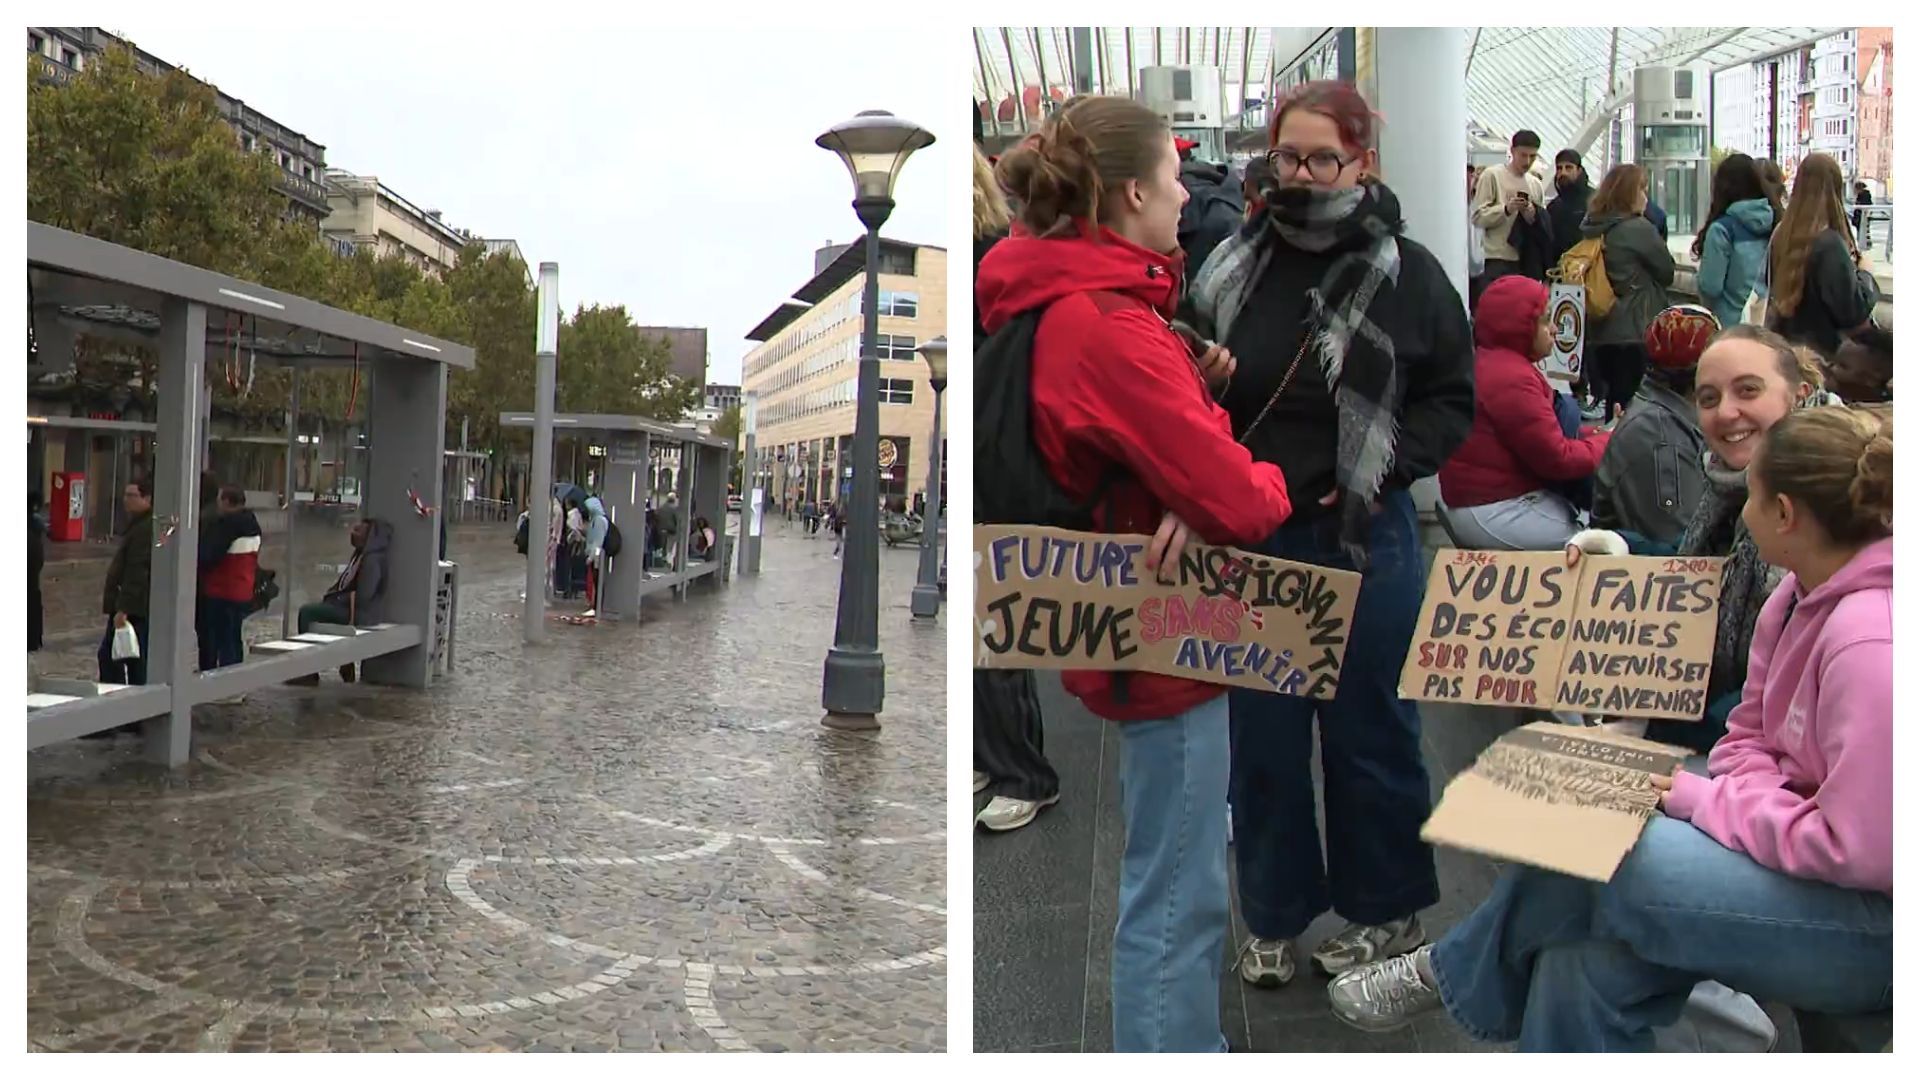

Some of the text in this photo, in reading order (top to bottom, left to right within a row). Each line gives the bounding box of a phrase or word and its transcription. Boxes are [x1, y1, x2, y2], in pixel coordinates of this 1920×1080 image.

[990, 535, 1143, 587] FUTURE
[1446, 564, 1714, 614] VOUS FAITES
[983, 591, 1243, 661] JEUNE SANS
[1430, 602, 1497, 641] DES
[1173, 637, 1308, 695] AVENIR
[1418, 641, 1709, 683] SUR NOS AVENIRS ET
[1423, 673, 1704, 715] PAS POUR NOS AVENIRS
